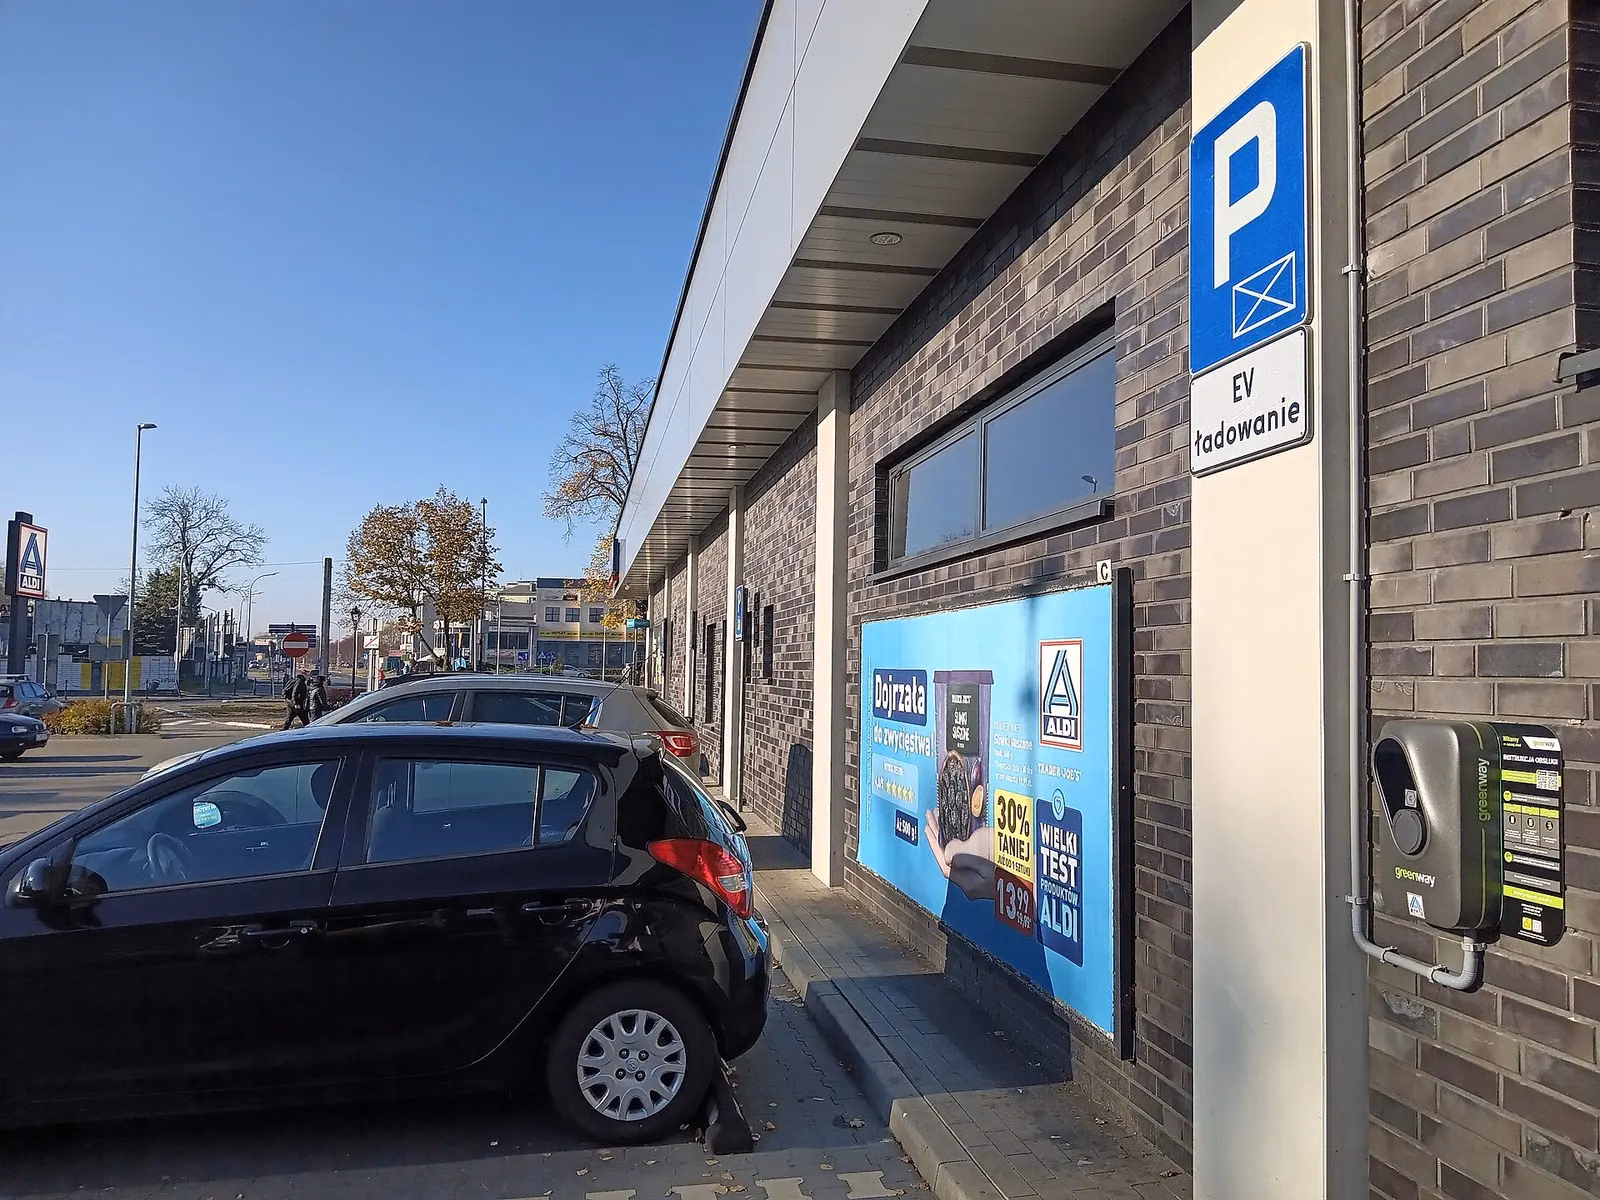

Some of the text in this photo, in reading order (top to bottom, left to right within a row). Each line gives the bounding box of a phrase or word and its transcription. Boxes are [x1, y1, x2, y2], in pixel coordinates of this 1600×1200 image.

[1213, 100, 1278, 289] P
[1232, 367, 1255, 403] EV
[1194, 396, 1301, 456] ładowanie
[21, 575, 41, 590] ALDI
[1100, 562, 1110, 581] C
[875, 674, 926, 718] Dojrzała
[873, 721, 883, 745] do
[1046, 717, 1076, 738] ALDI
[1037, 761, 1061, 778] TRADER
[1061, 767, 1082, 782] JOE'S
[1478, 757, 1491, 822] greenway
[997, 795, 1030, 838] 30%
[997, 831, 1030, 863] TANIEJ
[1039, 822, 1078, 857] WIELKI
[1040, 845, 1078, 889] TEST
[1394, 866, 1436, 888] greenway
[1040, 877, 1079, 908] PRODUKTÓW
[1039, 894, 1078, 944] ALDI
